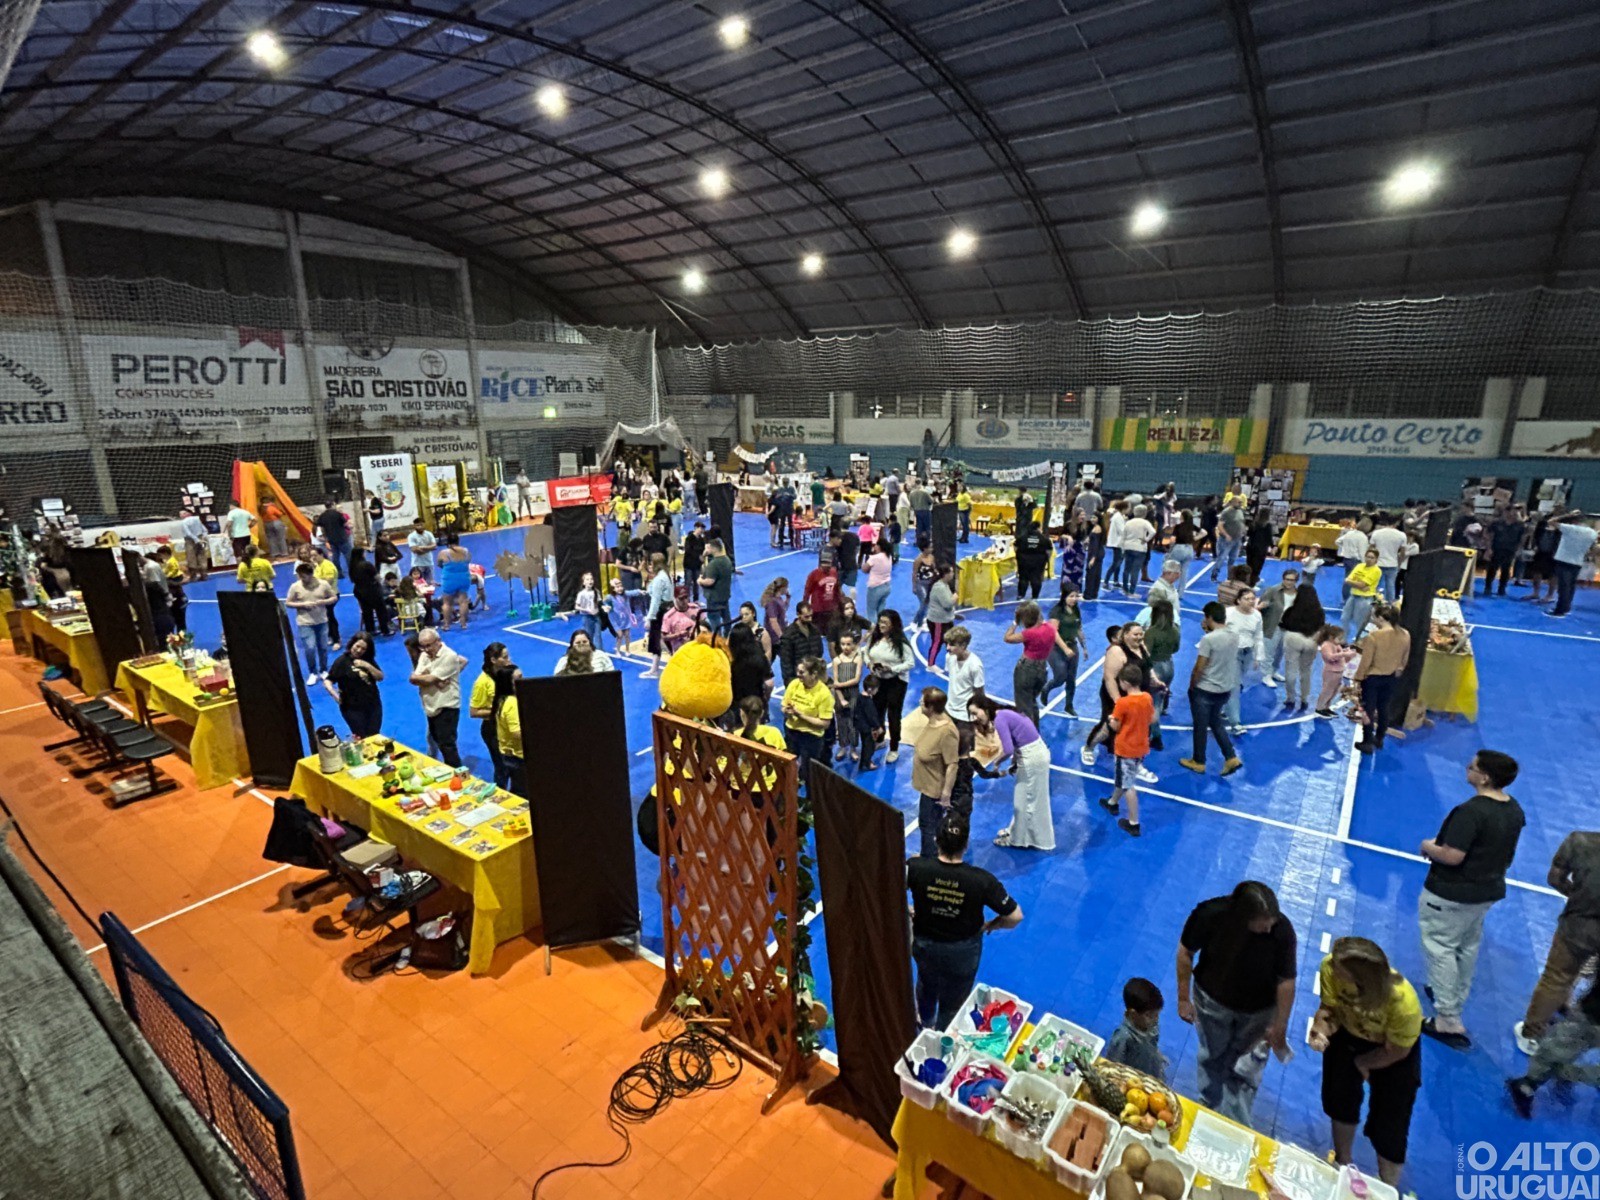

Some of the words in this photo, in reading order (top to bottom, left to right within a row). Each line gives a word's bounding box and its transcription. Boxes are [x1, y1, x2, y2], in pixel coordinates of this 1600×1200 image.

[110, 353, 287, 386] PEROTTI
[1147, 427, 1220, 441] REALEZA
[1394, 422, 1483, 445] Certo
[370, 458, 403, 468] SEBERI
